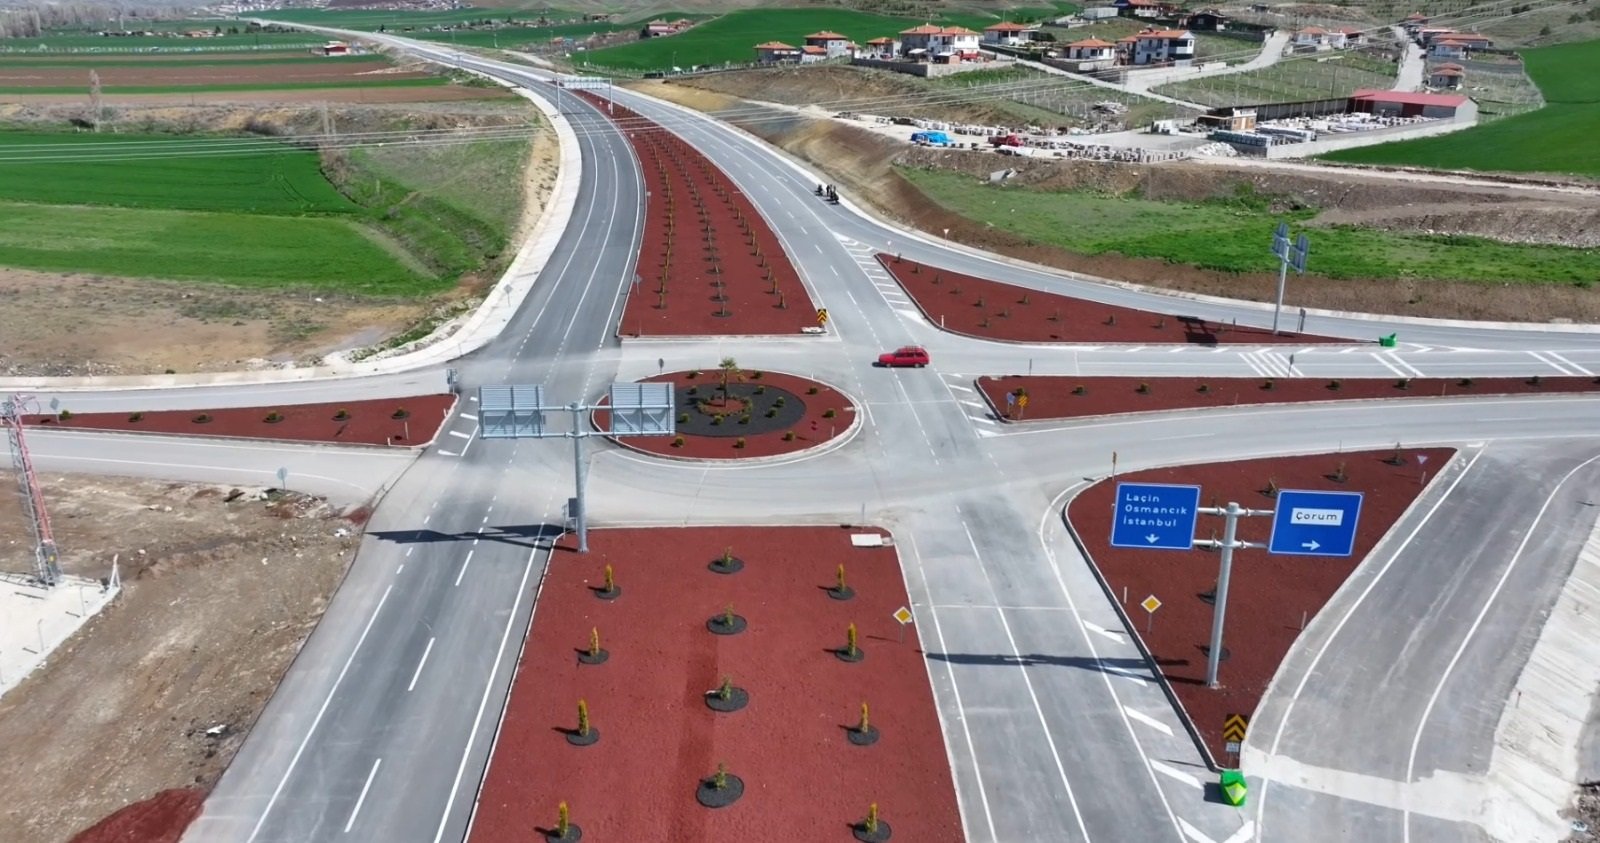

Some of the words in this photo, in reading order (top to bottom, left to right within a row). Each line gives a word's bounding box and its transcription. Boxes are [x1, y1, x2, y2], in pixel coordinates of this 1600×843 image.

[1126, 493, 1160, 503] Laçin
[1125, 504, 1187, 514] Osmancık
[1123, 515, 1177, 526] İstanbul
[1296, 511, 1337, 521] Çorum
